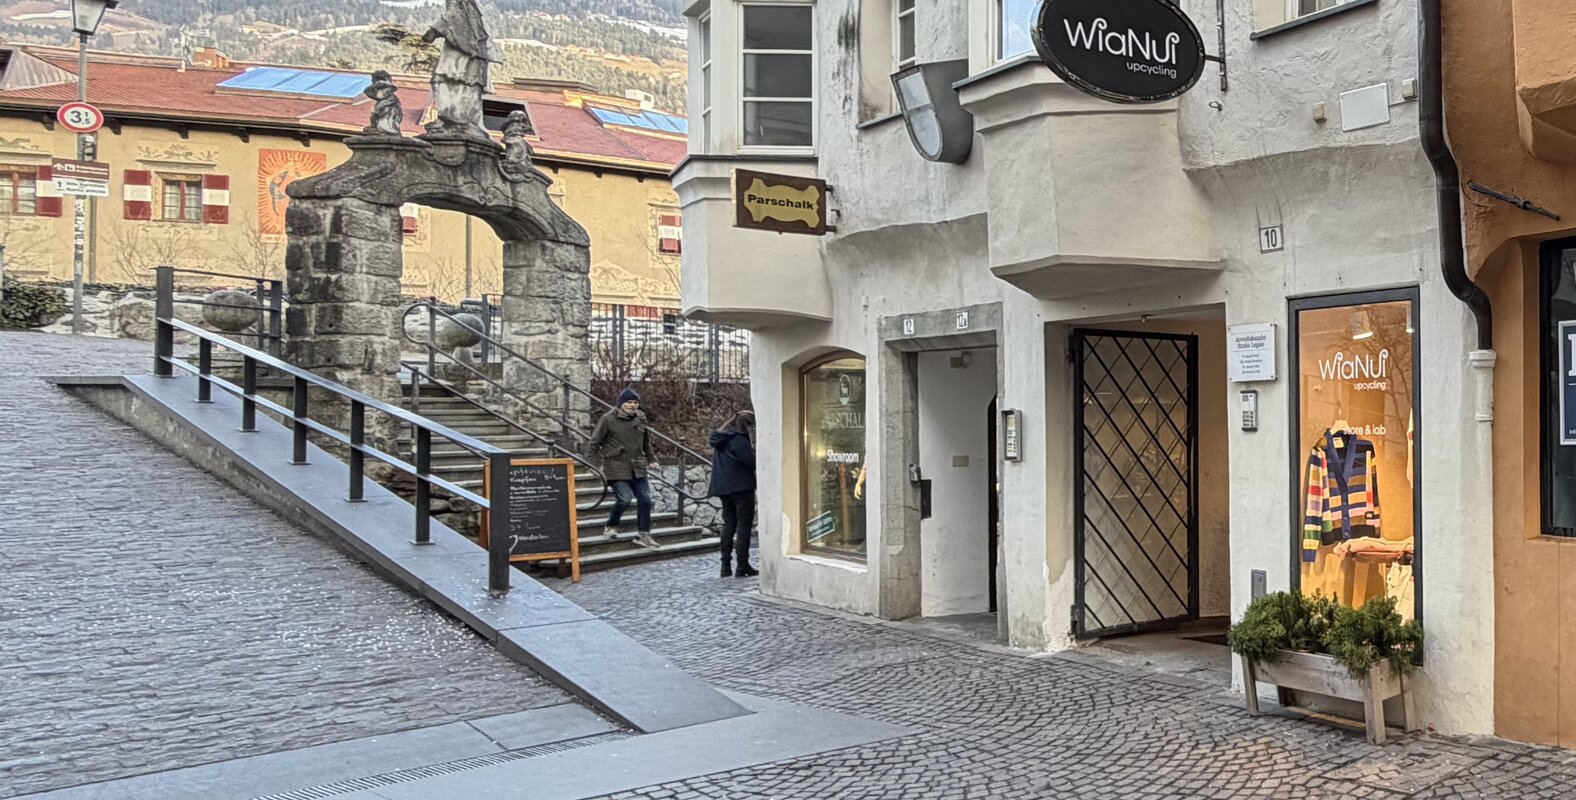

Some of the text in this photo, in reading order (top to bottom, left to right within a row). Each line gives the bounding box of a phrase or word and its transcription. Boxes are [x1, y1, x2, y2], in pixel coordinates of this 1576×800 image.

[1063, 17, 1180, 65] WiaNui
[1126, 61, 1177, 79] upcycling
[747, 194, 814, 210] Parschalk
[1264, 228, 1278, 249] 10
[1318, 349, 1388, 380] WiaNui
[1353, 380, 1386, 391] upcycling
[1365, 424, 1371, 435] &
[1372, 423, 1387, 436] lab
[827, 449, 859, 463] Showroom
